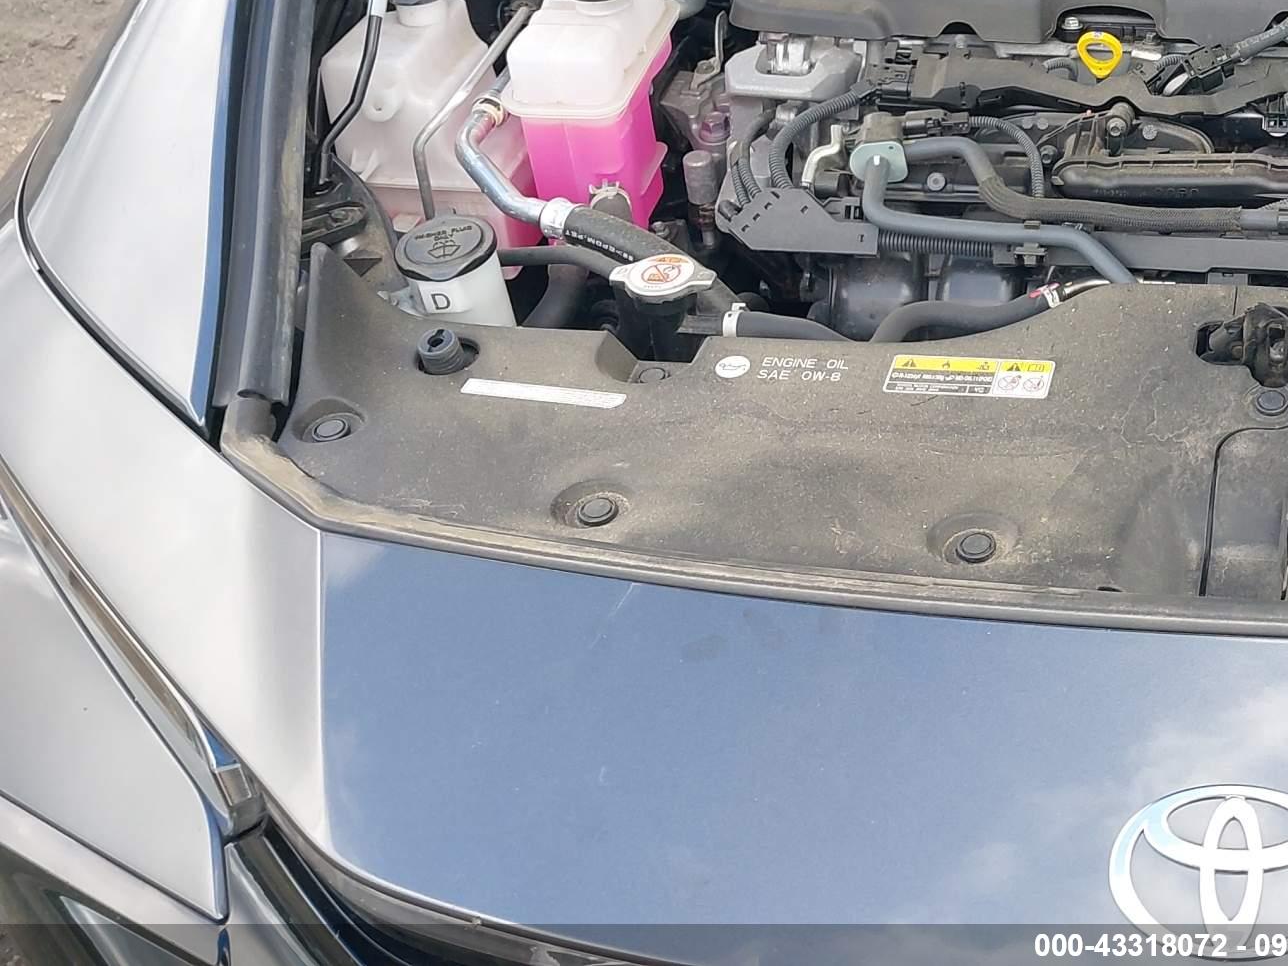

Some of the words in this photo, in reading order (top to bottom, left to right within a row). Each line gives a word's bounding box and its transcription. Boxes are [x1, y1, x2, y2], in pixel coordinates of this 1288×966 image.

[430, 292, 451, 311] D
[761, 356, 818, 369] ENGINE
[826, 358, 850, 370] OIL
[756, 369, 790, 381] SAE
